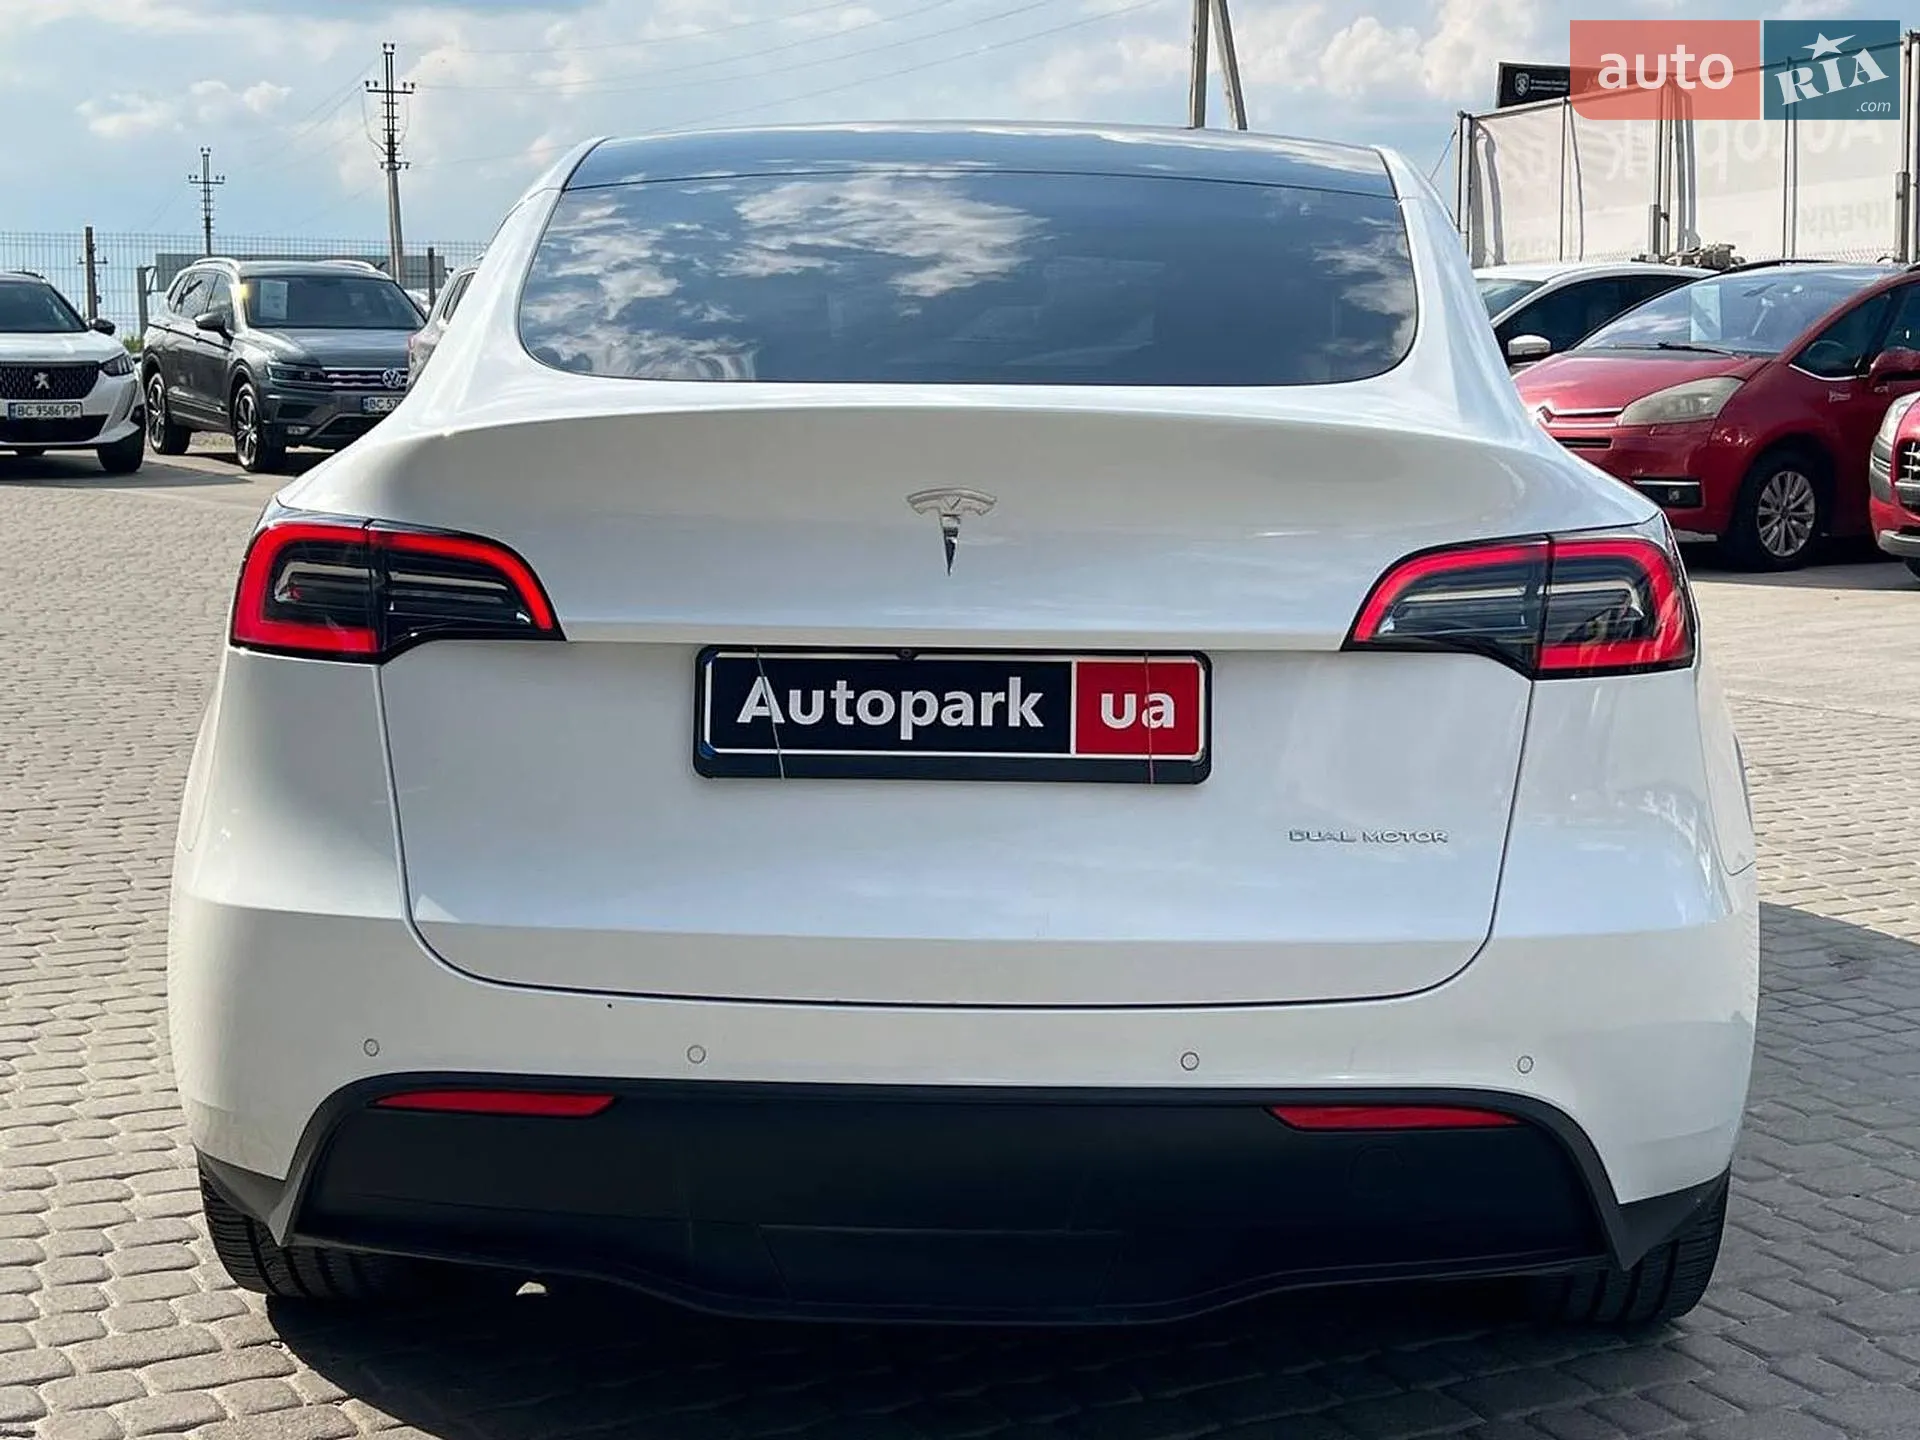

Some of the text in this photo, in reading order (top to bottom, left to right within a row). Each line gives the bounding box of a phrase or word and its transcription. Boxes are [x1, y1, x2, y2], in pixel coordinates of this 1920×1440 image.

[736, 676, 1177, 741] Autopark ua
[1288, 830, 1449, 844] DUAL MOTOR
